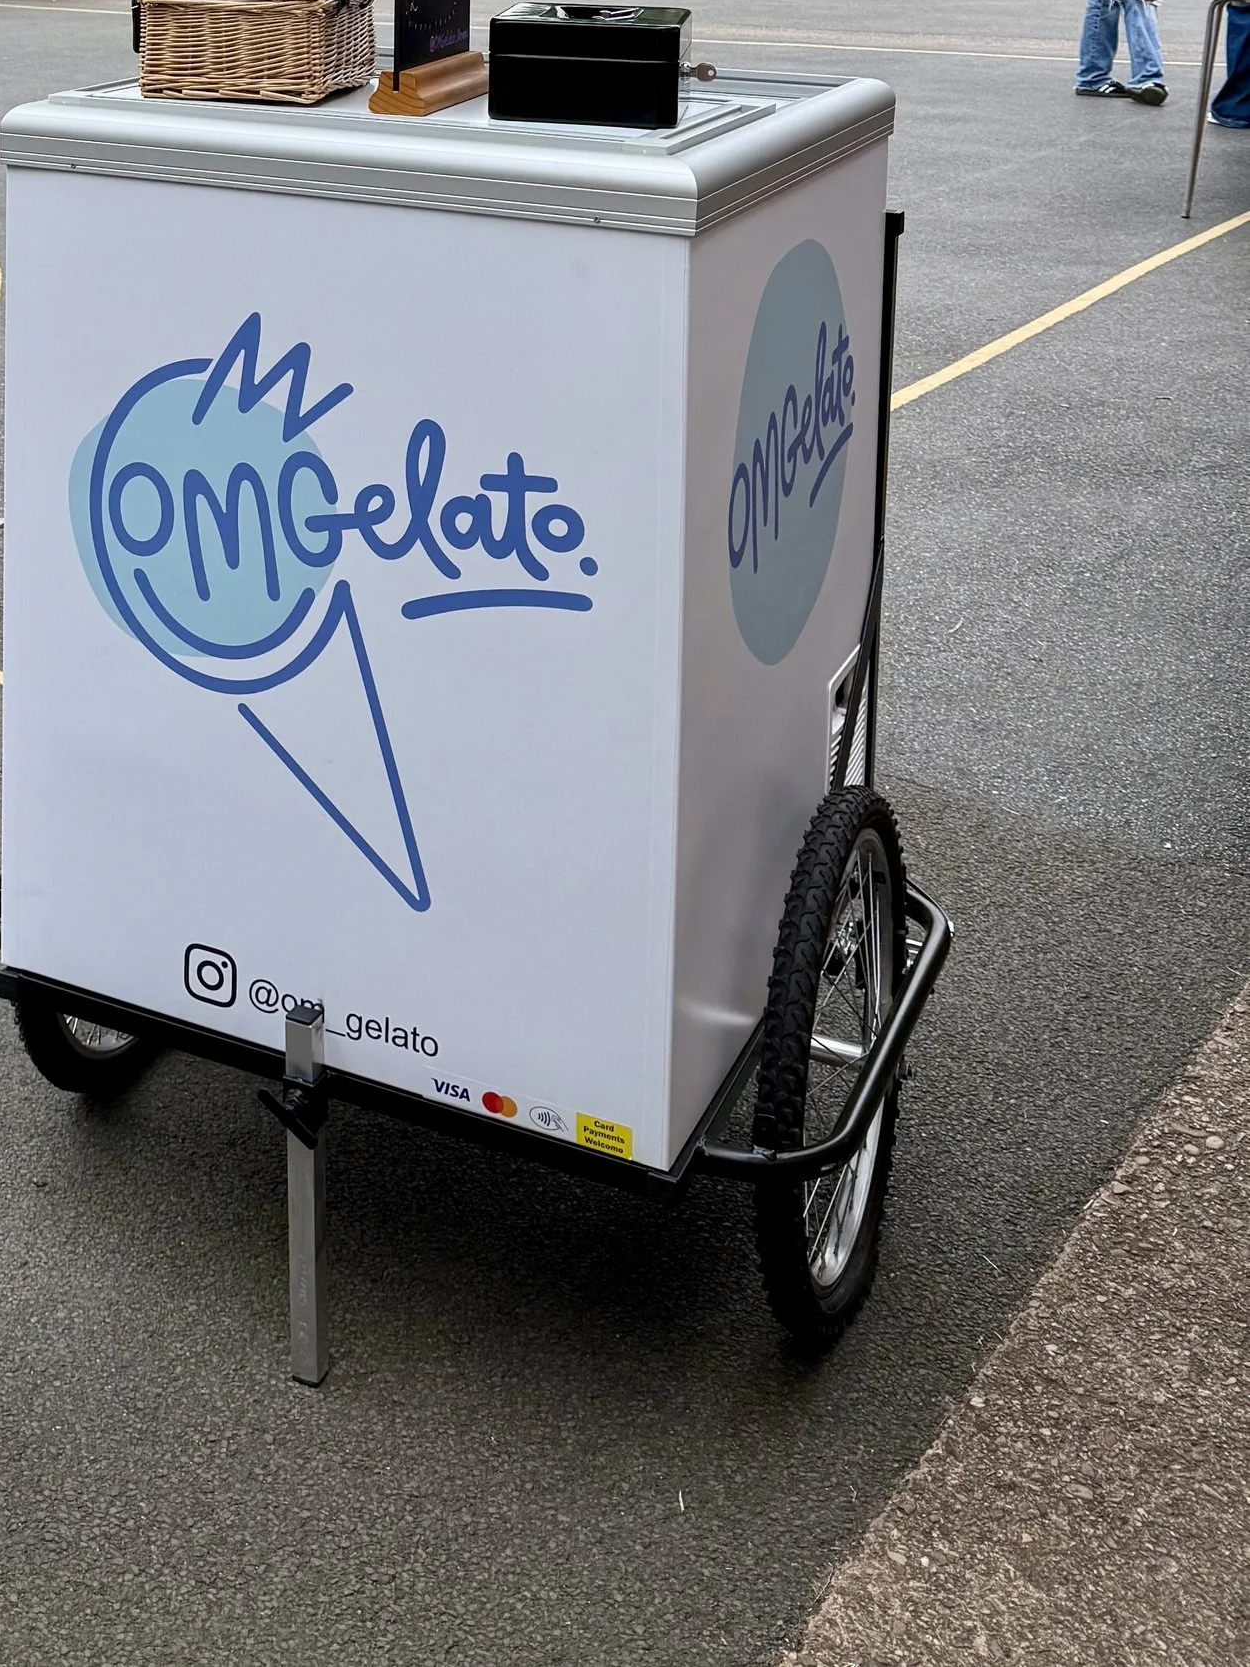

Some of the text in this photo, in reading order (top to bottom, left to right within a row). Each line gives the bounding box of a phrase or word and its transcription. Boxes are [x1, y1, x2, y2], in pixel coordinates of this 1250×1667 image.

[431, 1077, 471, 1103] VISA
[583, 1125, 625, 1144] Payments
[594, 1120, 615, 1132] Card
[584, 1136, 624, 1154] Welcome
